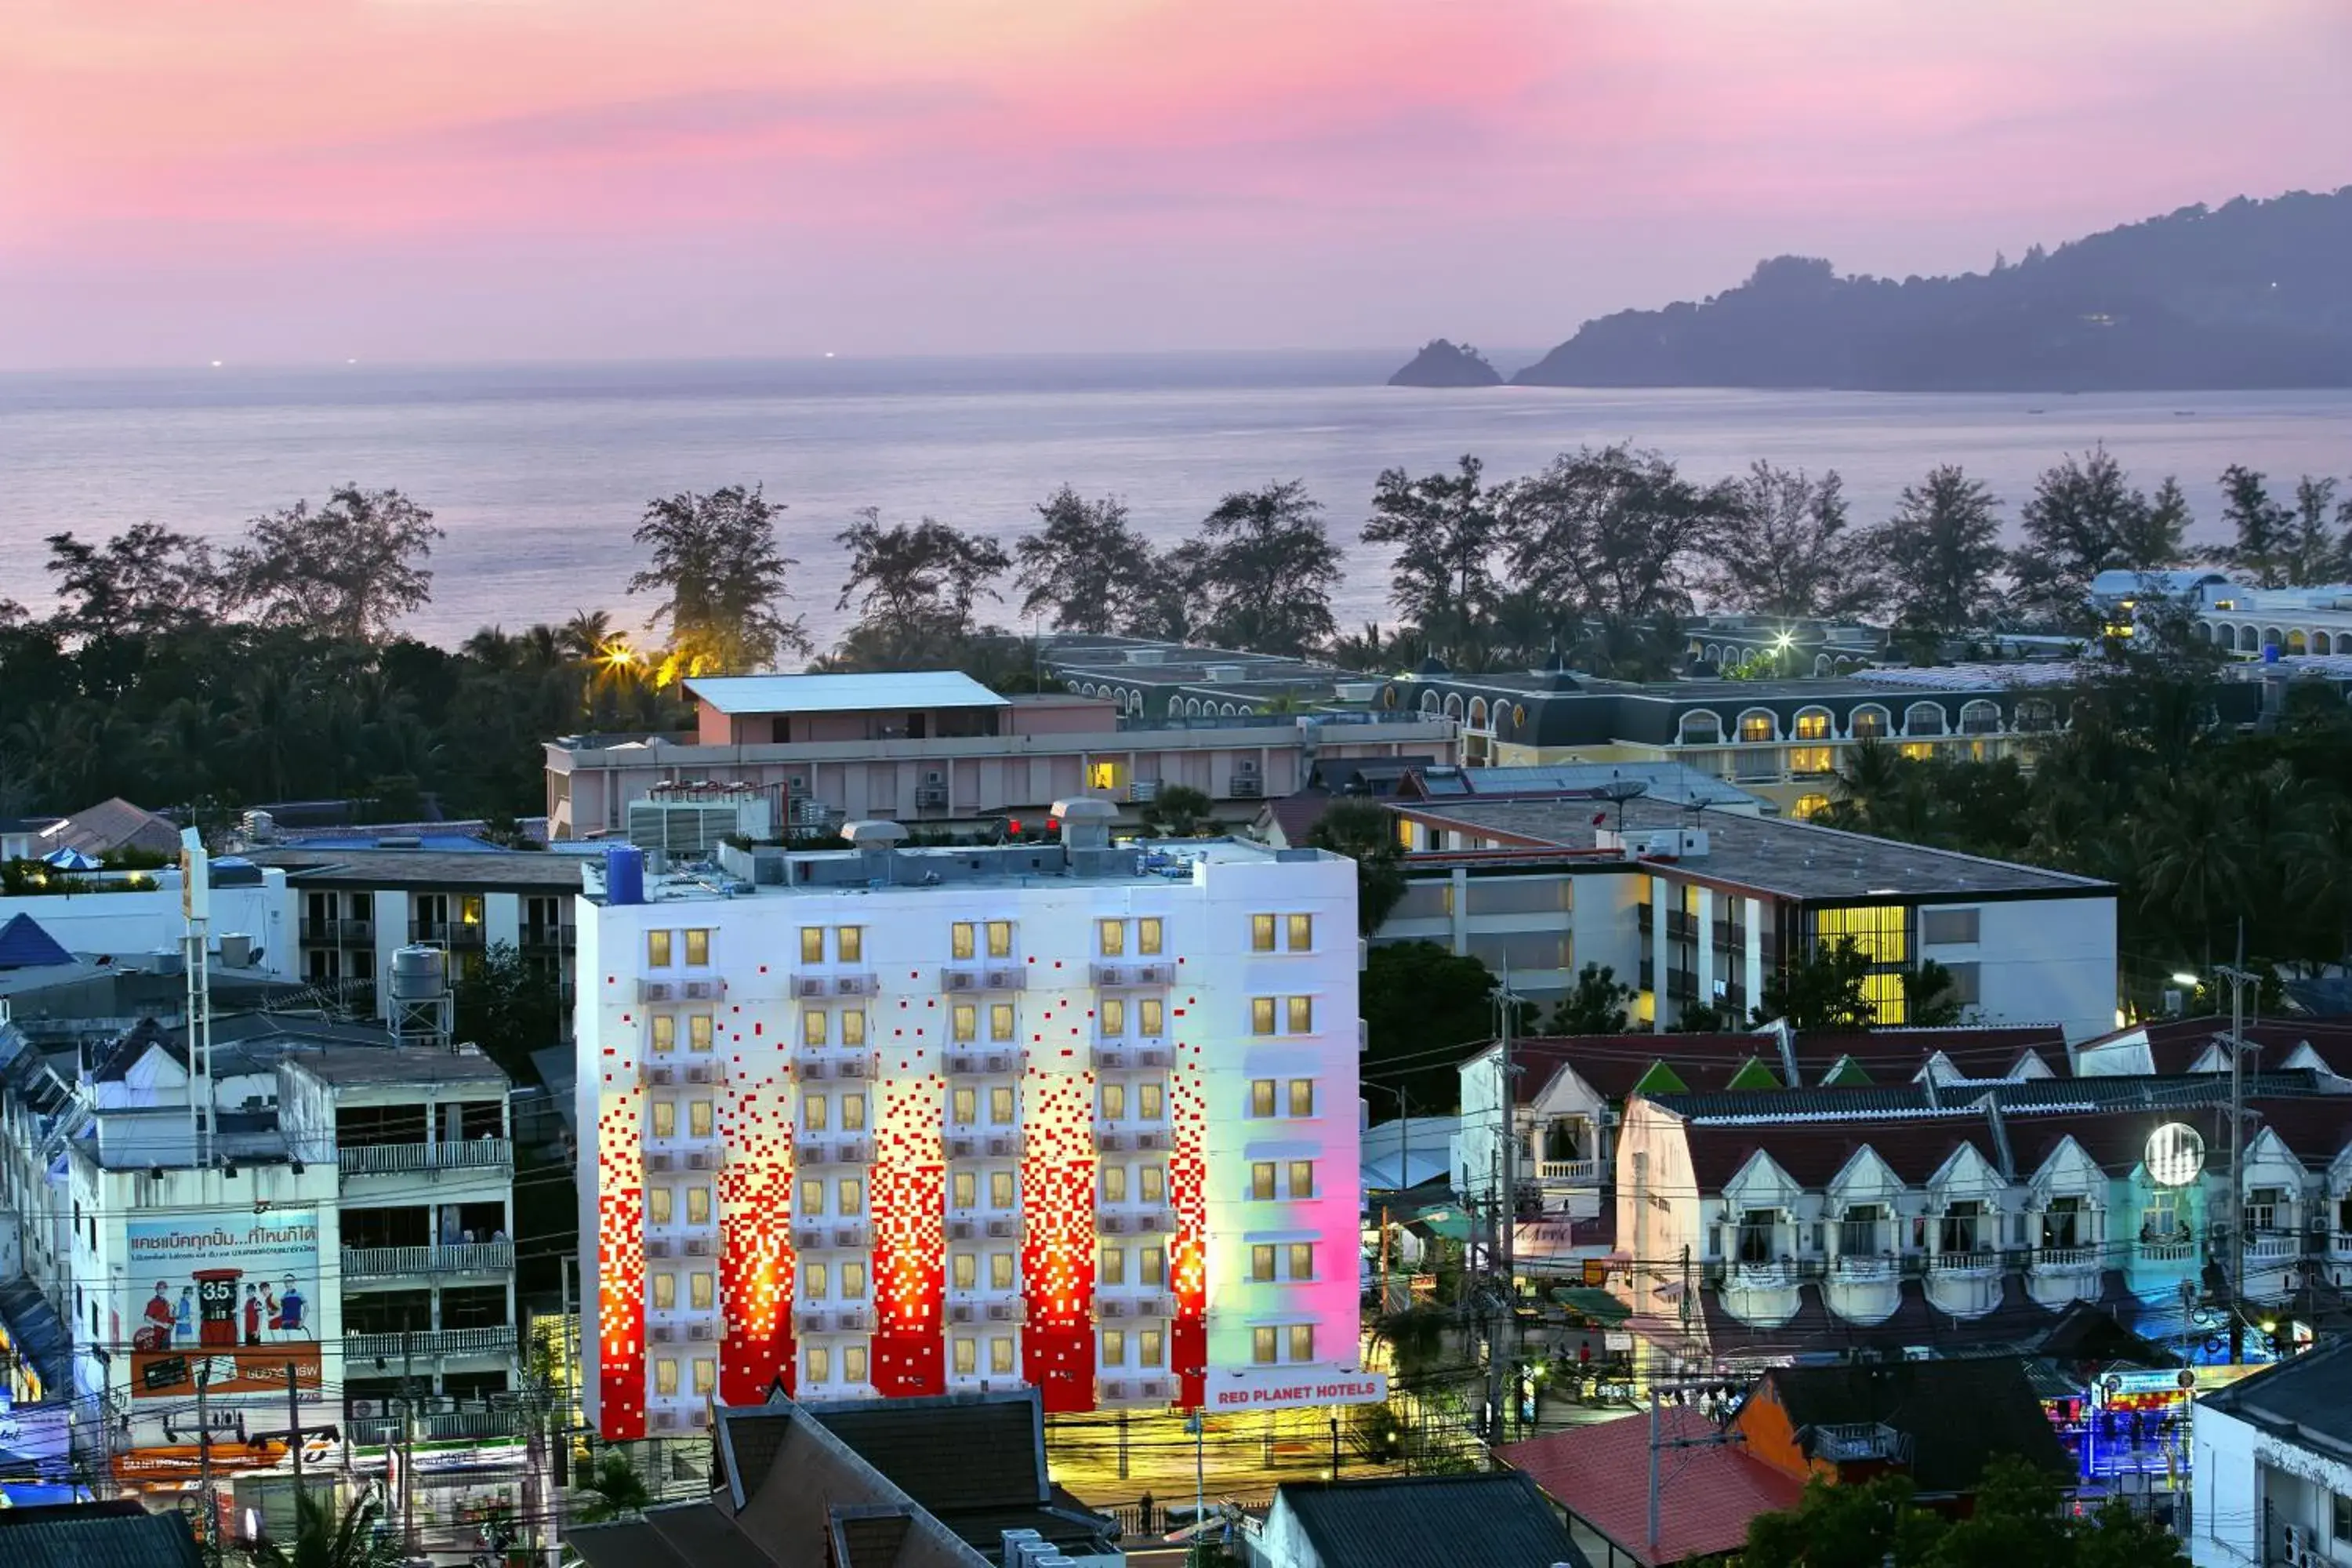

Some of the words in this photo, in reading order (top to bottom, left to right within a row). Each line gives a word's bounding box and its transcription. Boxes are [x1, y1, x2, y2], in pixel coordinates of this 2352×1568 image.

[1218, 1392, 1249, 1404] RED
[1254, 1385, 1312, 1402] PLANET
[1316, 1382, 1375, 1397] HOTELS
